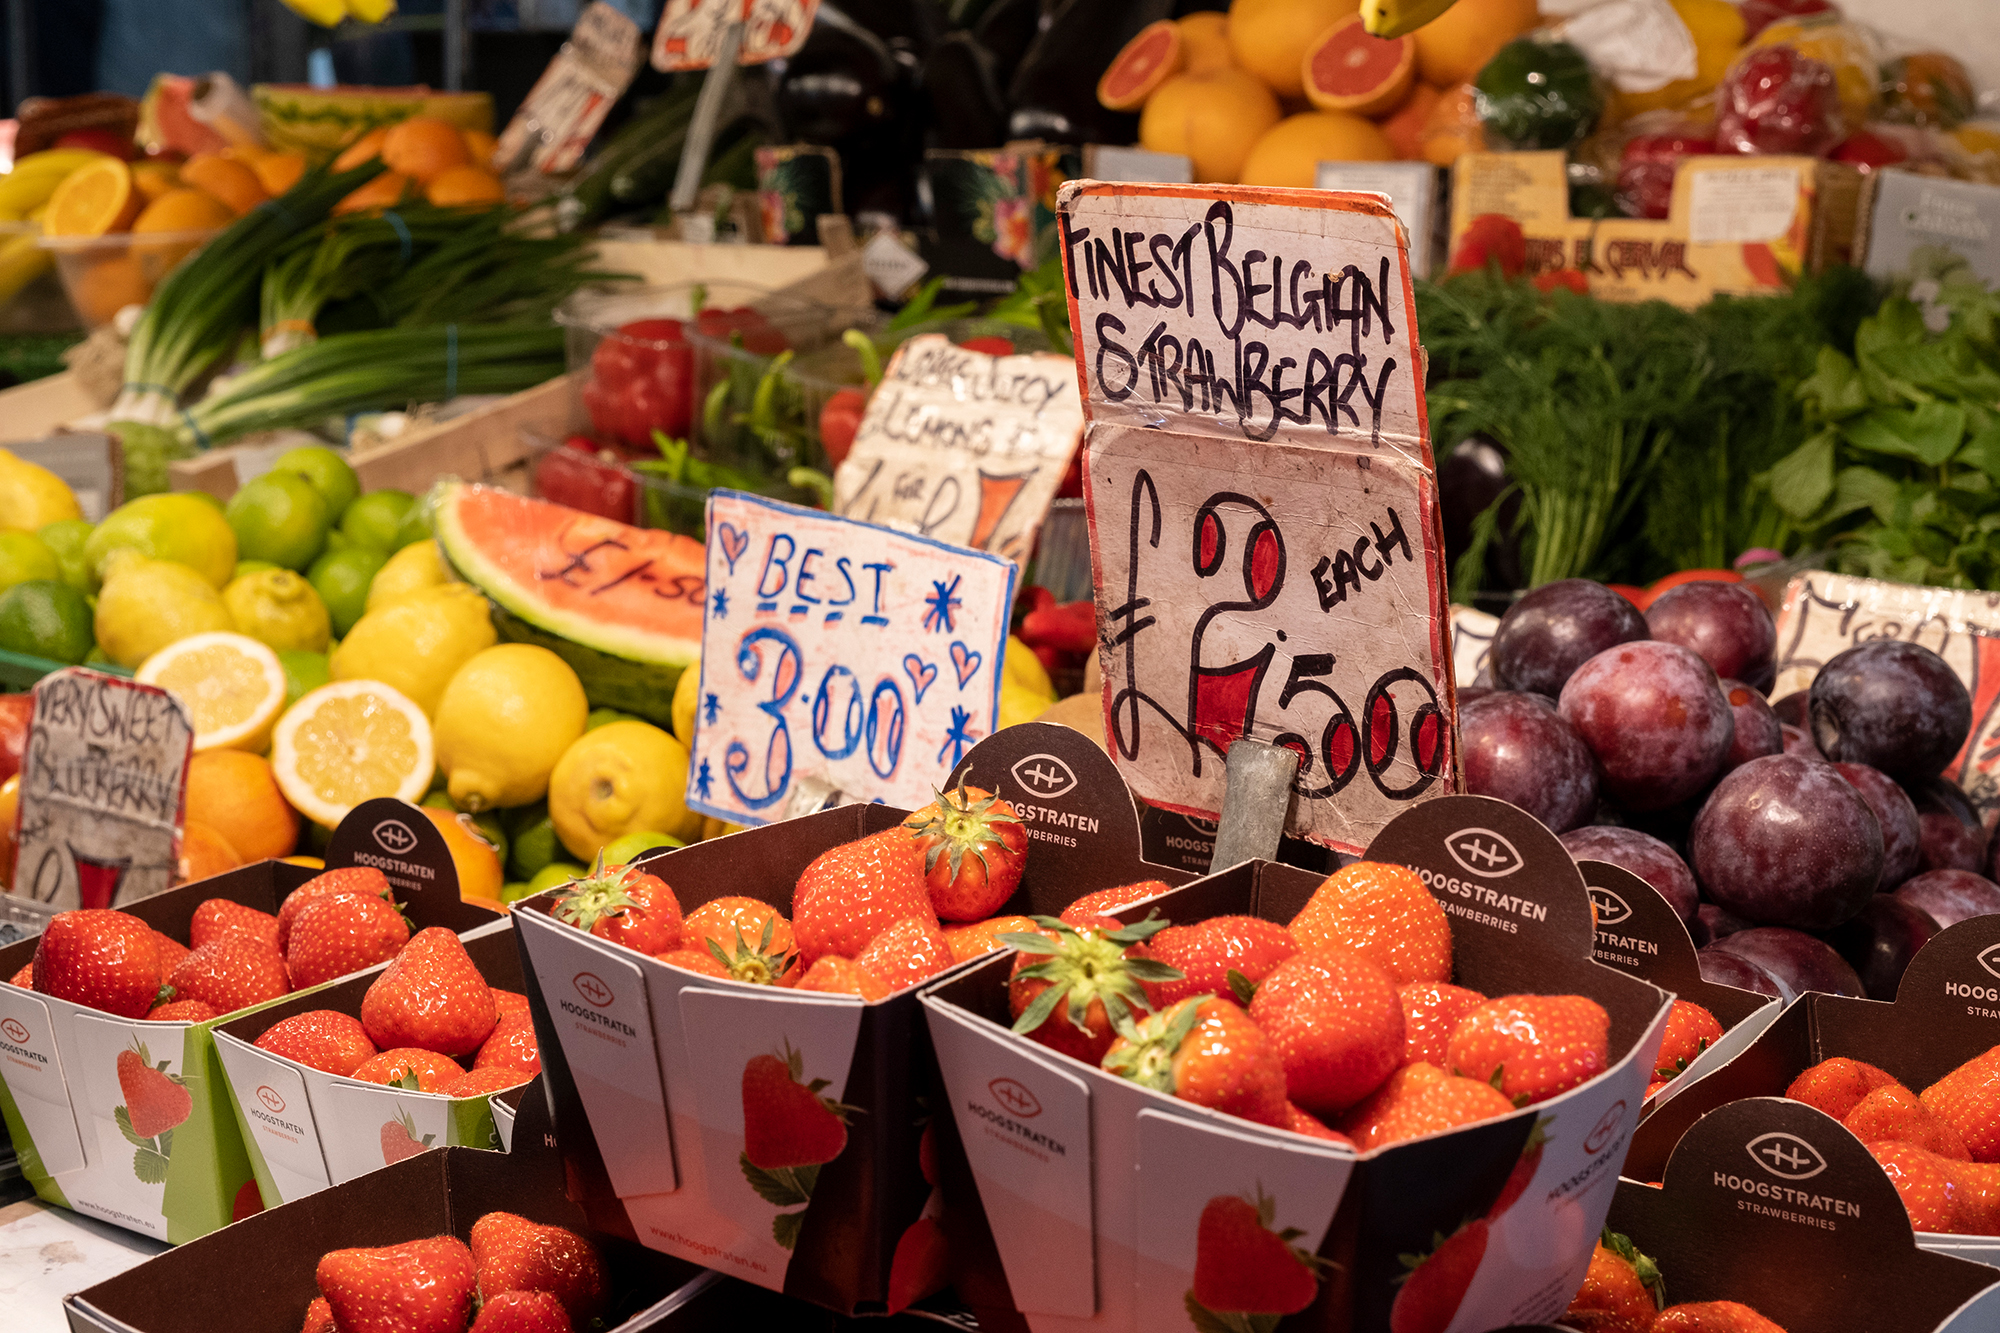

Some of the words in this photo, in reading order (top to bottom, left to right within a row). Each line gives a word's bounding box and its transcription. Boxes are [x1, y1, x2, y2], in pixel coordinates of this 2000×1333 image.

[1205, 200, 1397, 348] BELGIAN
[1096, 312, 1397, 449] STRAWBERRY
[757, 534, 896, 615] BEST
[1311, 507, 1413, 612] EACH
[724, 625, 903, 810] 3.00
[1003, 799, 1099, 834] OGSTRATEN
[1165, 835, 1216, 854] HOOGST
[353, 850, 436, 881] HOOGSTRATEN
[1593, 930, 1659, 956] STRATEN
[559, 999, 638, 1039] HOOGSTRATEN
[0, 1040, 49, 1064] OOGSTRATEN
[250, 1107, 305, 1136] HOOGSTRATEN
[968, 1100, 1066, 1156] HOOGSTRATEN
[1713, 1170, 1861, 1219] HOOGSTRATEN
[1736, 1199, 1837, 1231] STRAWBERRIES
